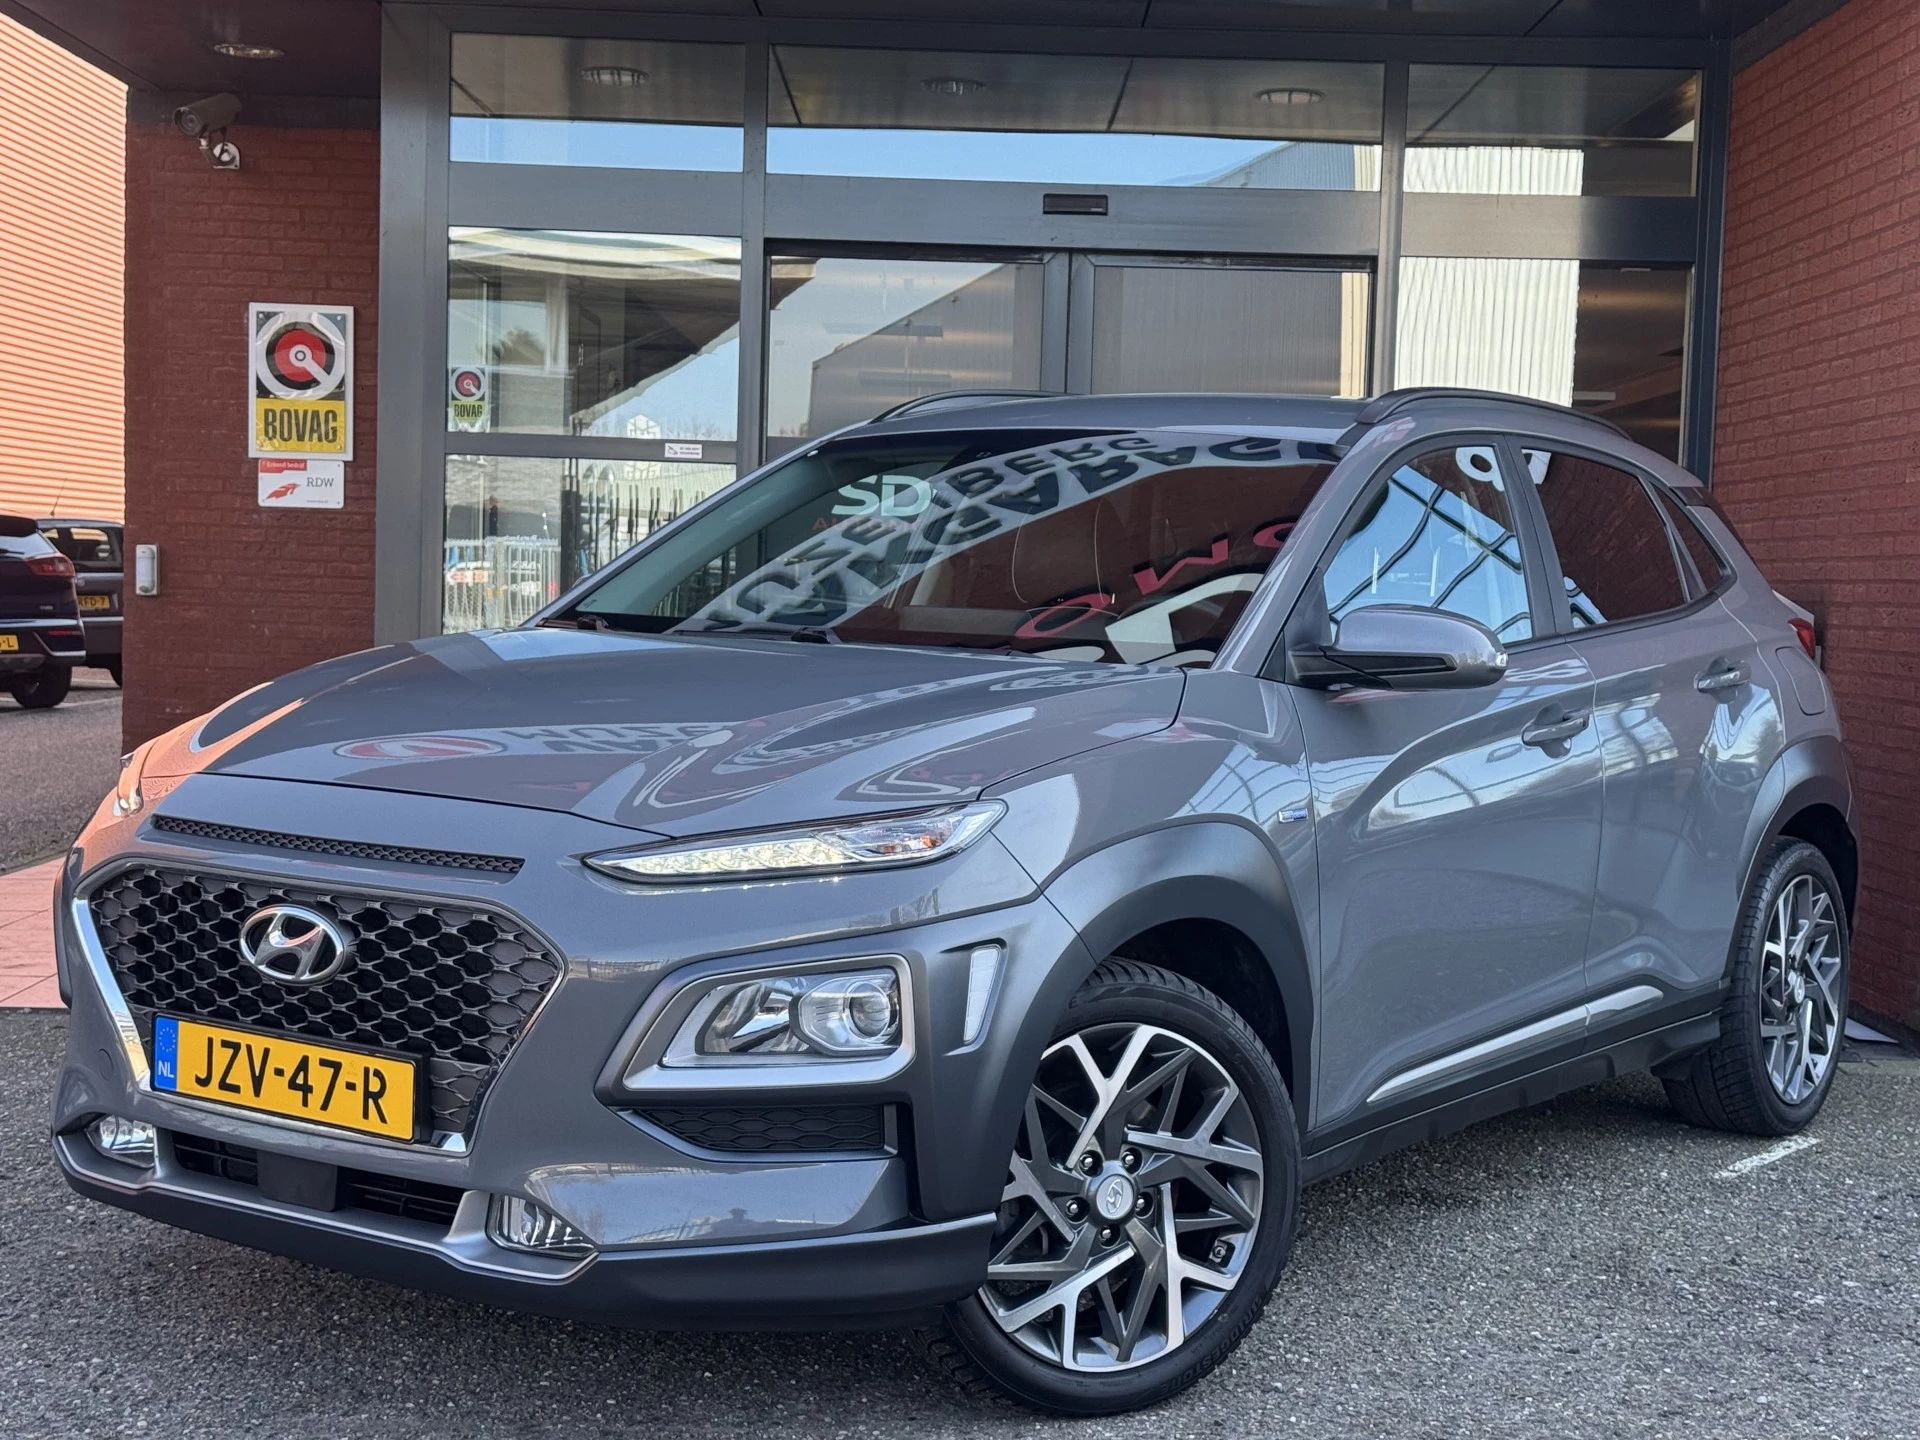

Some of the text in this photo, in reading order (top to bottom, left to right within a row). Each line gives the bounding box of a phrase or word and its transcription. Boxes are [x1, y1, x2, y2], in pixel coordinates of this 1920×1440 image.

[263, 408, 338, 443] BOVAG
[454, 403, 483, 418] BOVAG
[306, 477, 334, 488] RDW
[831, 474, 933, 517] SD
[158, 1036, 388, 1125] NL JZV-47-R
